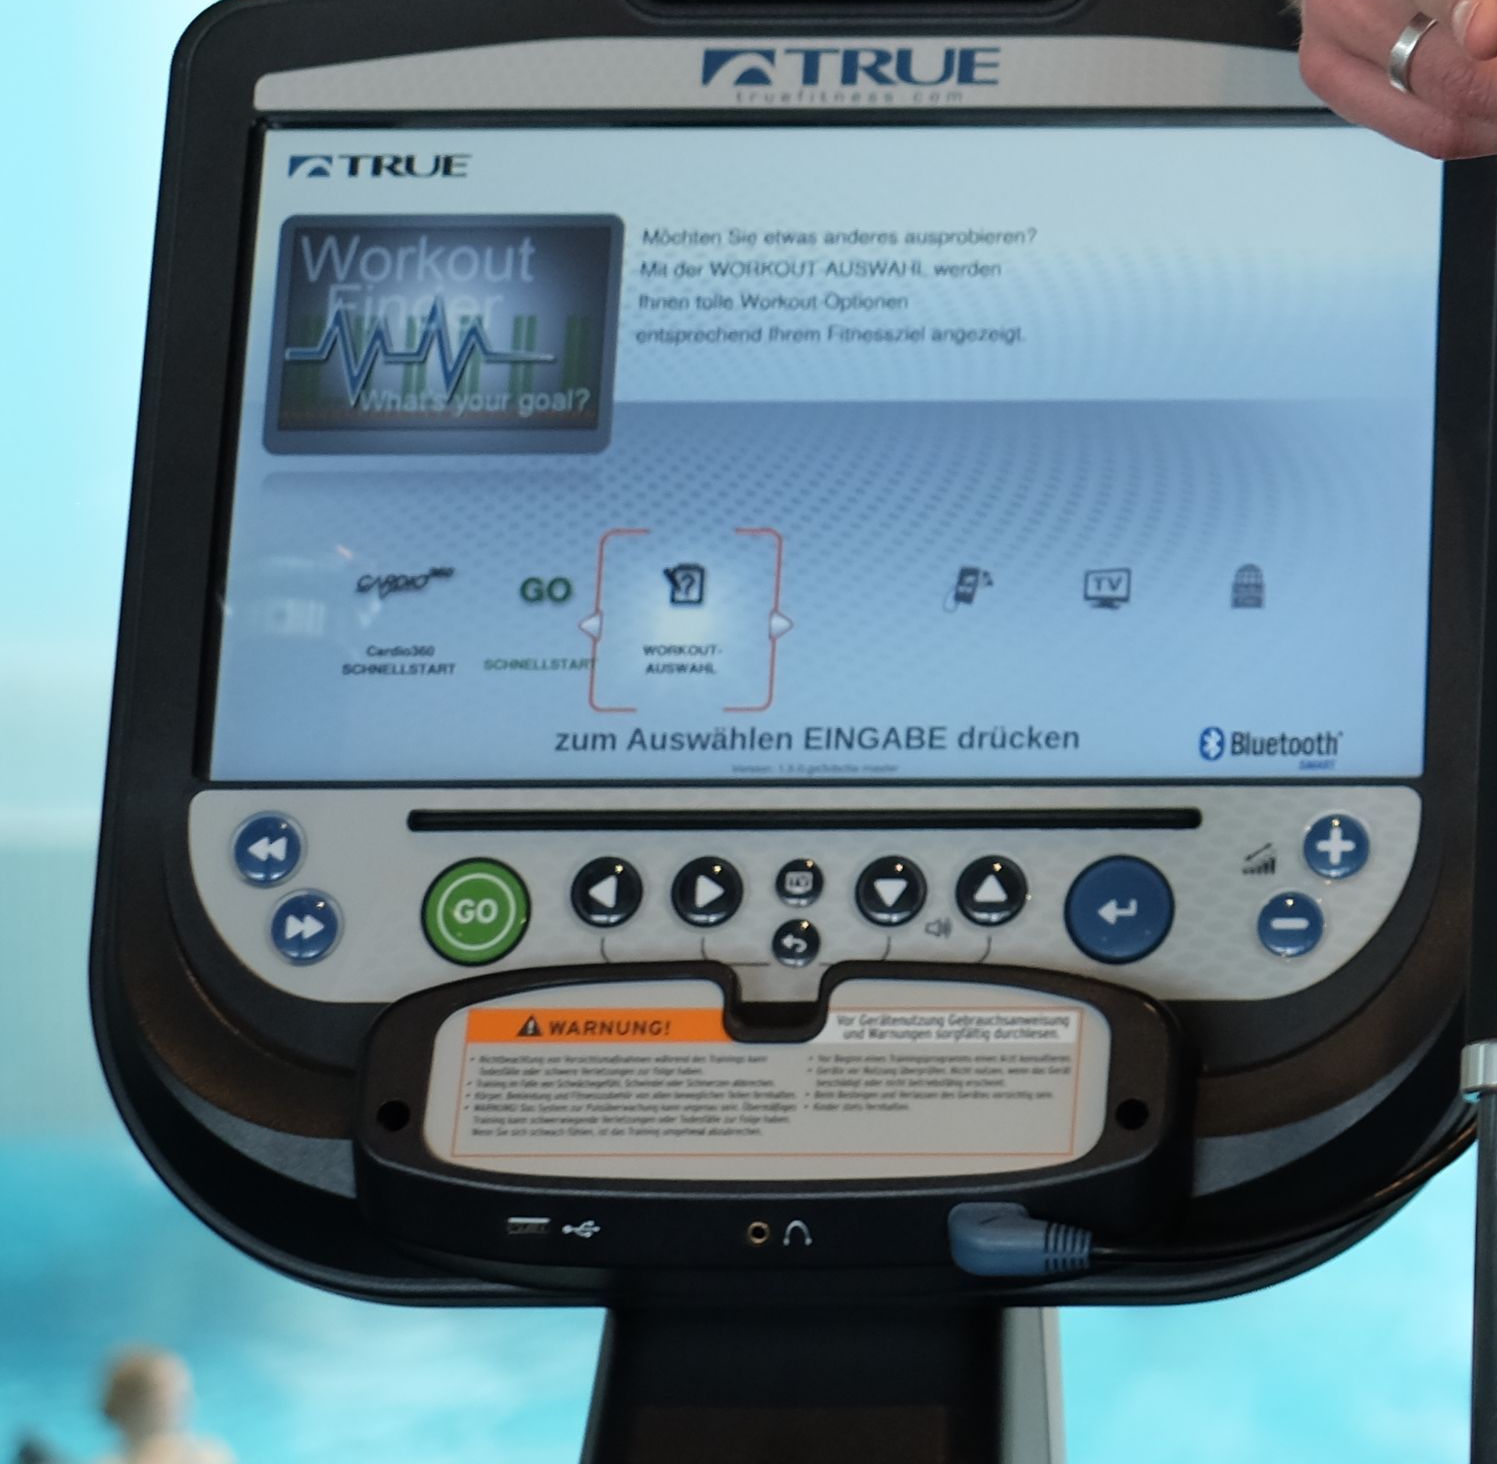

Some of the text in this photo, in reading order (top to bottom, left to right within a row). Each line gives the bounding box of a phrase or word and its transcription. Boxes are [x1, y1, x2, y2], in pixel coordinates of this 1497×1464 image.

[784, 47, 1000, 86] TRUE
[735, 89, 963, 104] truefitnesscom
[338, 153, 472, 178] TRUE
[642, 226, 1038, 249] Möchten Sie etwas anderes ausprobieren?
[301, 235, 536, 283] Workout
[639, 259, 1002, 279] Mit der WORKOUT AUSWAHL werden
[638, 291, 909, 314] Ihnen tolle Workout Optionen
[635, 326, 763, 348] entsprechend
[768, 326, 821, 344] Ihrem
[827, 325, 926, 344] Fitnessziel
[358, 388, 591, 418] What's your goal?
[519, 575, 574, 604] GO
[1093, 575, 1123, 592] TV
[366, 644, 436, 659] Cardio360
[642, 644, 723, 658] WORKOUT-
[340, 662, 456, 677] SCHNELLSTART
[483, 657, 599, 673] SCHNELLSTART
[644, 662, 718, 676] AUSWAHL
[554, 724, 1080, 752] zum Auswählen EINGABE drücken
[1230, 730, 1339, 757] Bluetooth
[452, 898, 499, 925] GO
[549, 1020, 672, 1036] WARNUNG!
